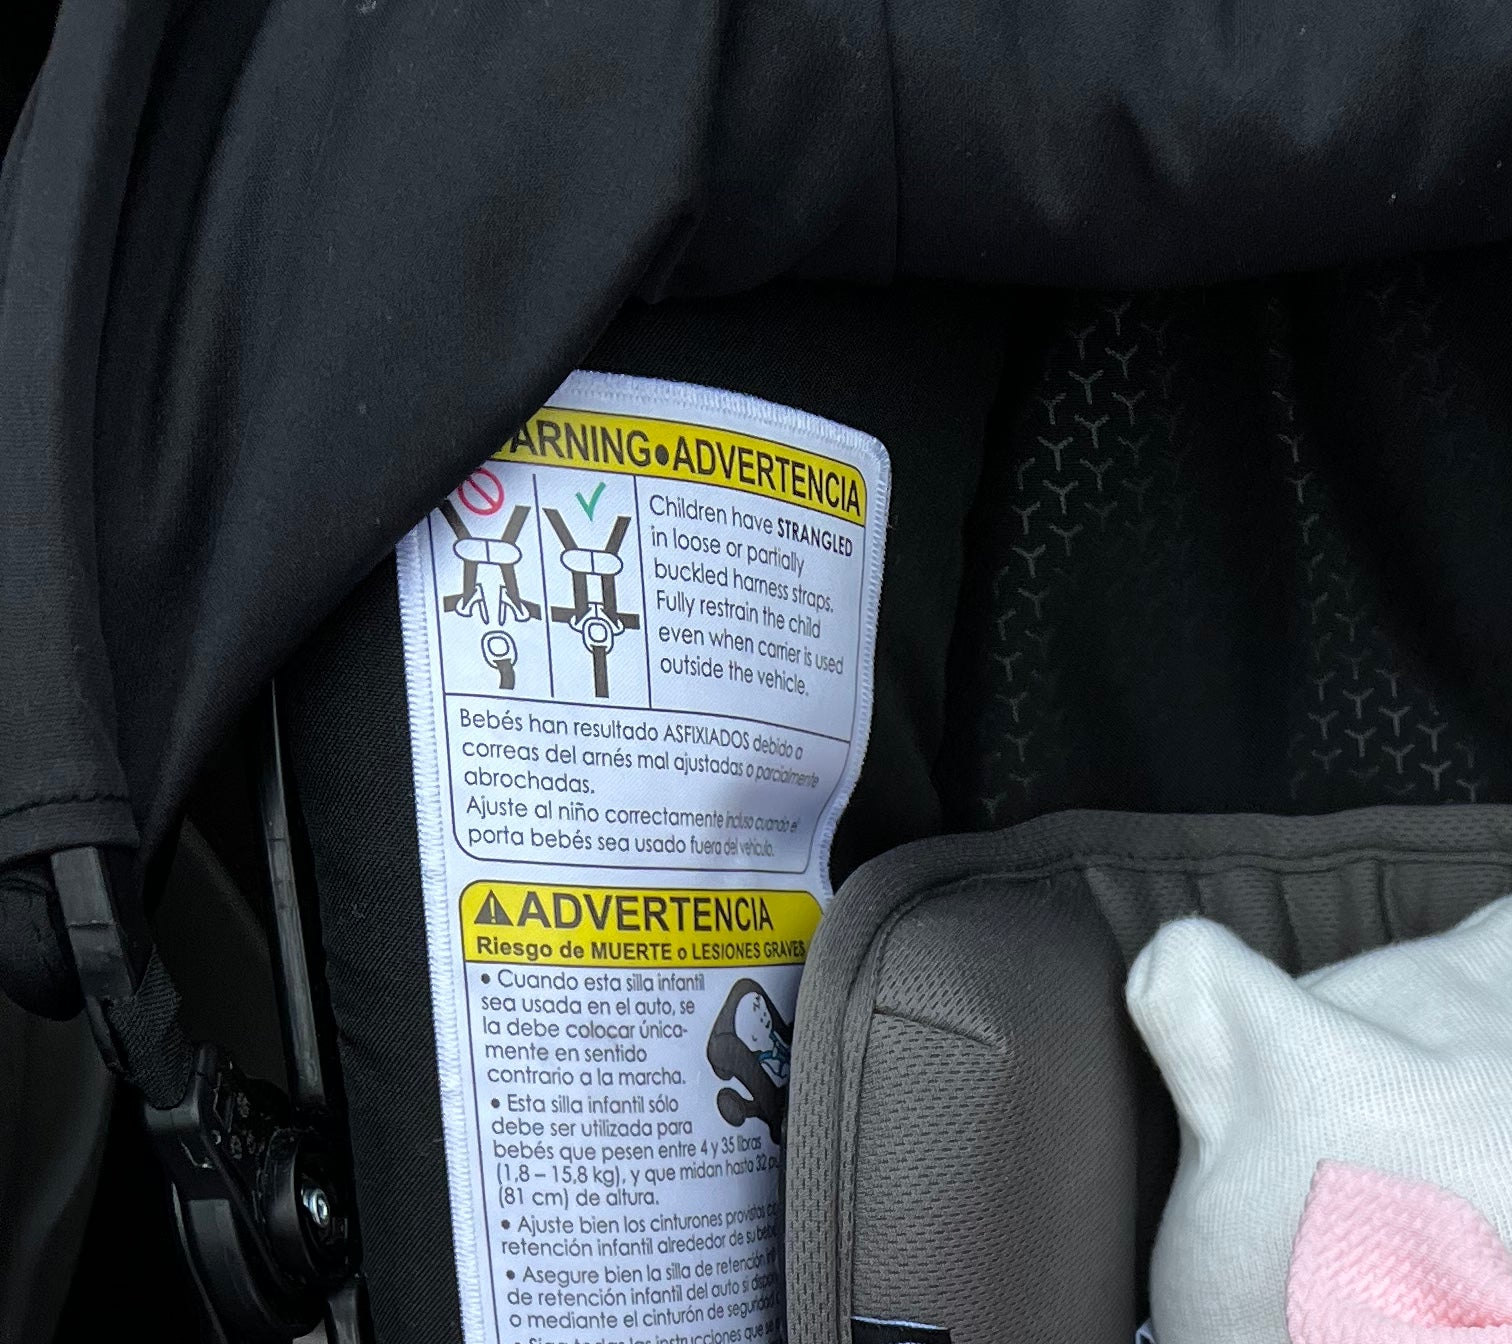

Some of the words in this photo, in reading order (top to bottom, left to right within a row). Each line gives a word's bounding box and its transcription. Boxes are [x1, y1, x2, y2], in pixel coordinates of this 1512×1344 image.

[498, 420, 650, 467] ARNING
[672, 438, 861, 517] ADVERTENCIA
[650, 494, 727, 525] Children
[732, 506, 773, 534] have
[778, 517, 852, 557] STRANGLED
[651, 525, 667, 548] in
[673, 528, 720, 554] loose
[726, 542, 743, 558] or
[747, 545, 804, 578] partially
[654, 557, 728, 587] buckled
[733, 568, 788, 600] harness
[792, 584, 833, 613] straps.
[657, 590, 695, 618] Fully
[700, 598, 758, 624] restrain
[762, 606, 785, 630] the
[789, 614, 820, 638] child
[659, 626, 704, 646] even
[708, 628, 754, 654] when
[758, 640, 801, 664] carrier
[804, 646, 812, 666] is
[816, 654, 843, 674] used
[660, 654, 723, 678] outside
[728, 660, 753, 684] the
[757, 669, 808, 696] vehicle.
[460, 708, 523, 731] Bebés
[529, 714, 568, 735] han
[574, 720, 658, 741] resultado
[664, 724, 749, 750] ASFIXIADOS
[462, 742, 539, 762] correas
[546, 744, 576, 764] del
[582, 748, 632, 768] arnés
[638, 751, 669, 770] mal
[674, 752, 743, 776] ajustadas
[464, 766, 594, 794] abrochadas.
[466, 795, 528, 819] Ajuste
[535, 800, 552, 819] al
[559, 802, 599, 822] niño
[605, 807, 724, 828] correctamente
[468, 826, 524, 847] porta
[530, 828, 592, 850] bebés
[598, 836, 630, 852] sea
[635, 834, 686, 853] usado
[517, 891, 774, 932] ADVERTENCIA
[477, 936, 552, 962] Riesgo
[560, 940, 584, 959] de
[591, 942, 672, 960] MUERTE
[677, 947, 687, 960] o
[692, 942, 760, 960] LESIONES
[498, 969, 578, 990] Cuando
[584, 974, 621, 992] esta
[626, 974, 654, 992] silla
[658, 973, 704, 991] infantil
[481, 996, 516, 1012] sea
[522, 996, 582, 1014] usada
[588, 1000, 611, 1015] en
[616, 998, 630, 1016] el
[635, 998, 675, 1016] auto,
[680, 1000, 695, 1014] se
[483, 1016, 500, 1035] la
[507, 1018, 559, 1038] debe
[566, 1020, 635, 1039] colocar
[485, 1042, 548, 1061] mente
[555, 1048, 580, 1062] en
[584, 1044, 647, 1062] sentido
[487, 1066, 574, 1085] contrario
[580, 1072, 592, 1086] a
[597, 1068, 613, 1086] la
[619, 1067, 686, 1086] marcha.
[508, 1094, 545, 1112] Esta
[552, 1095, 583, 1114] silla
[588, 1096, 644, 1114] infantil
[649, 1094, 678, 1113] sólo
[518, 1215, 573, 1236] Ajuste
[579, 1216, 618, 1234] bien
[522, 1266, 599, 1287] Asegure
[604, 1266, 642, 1284] bien
